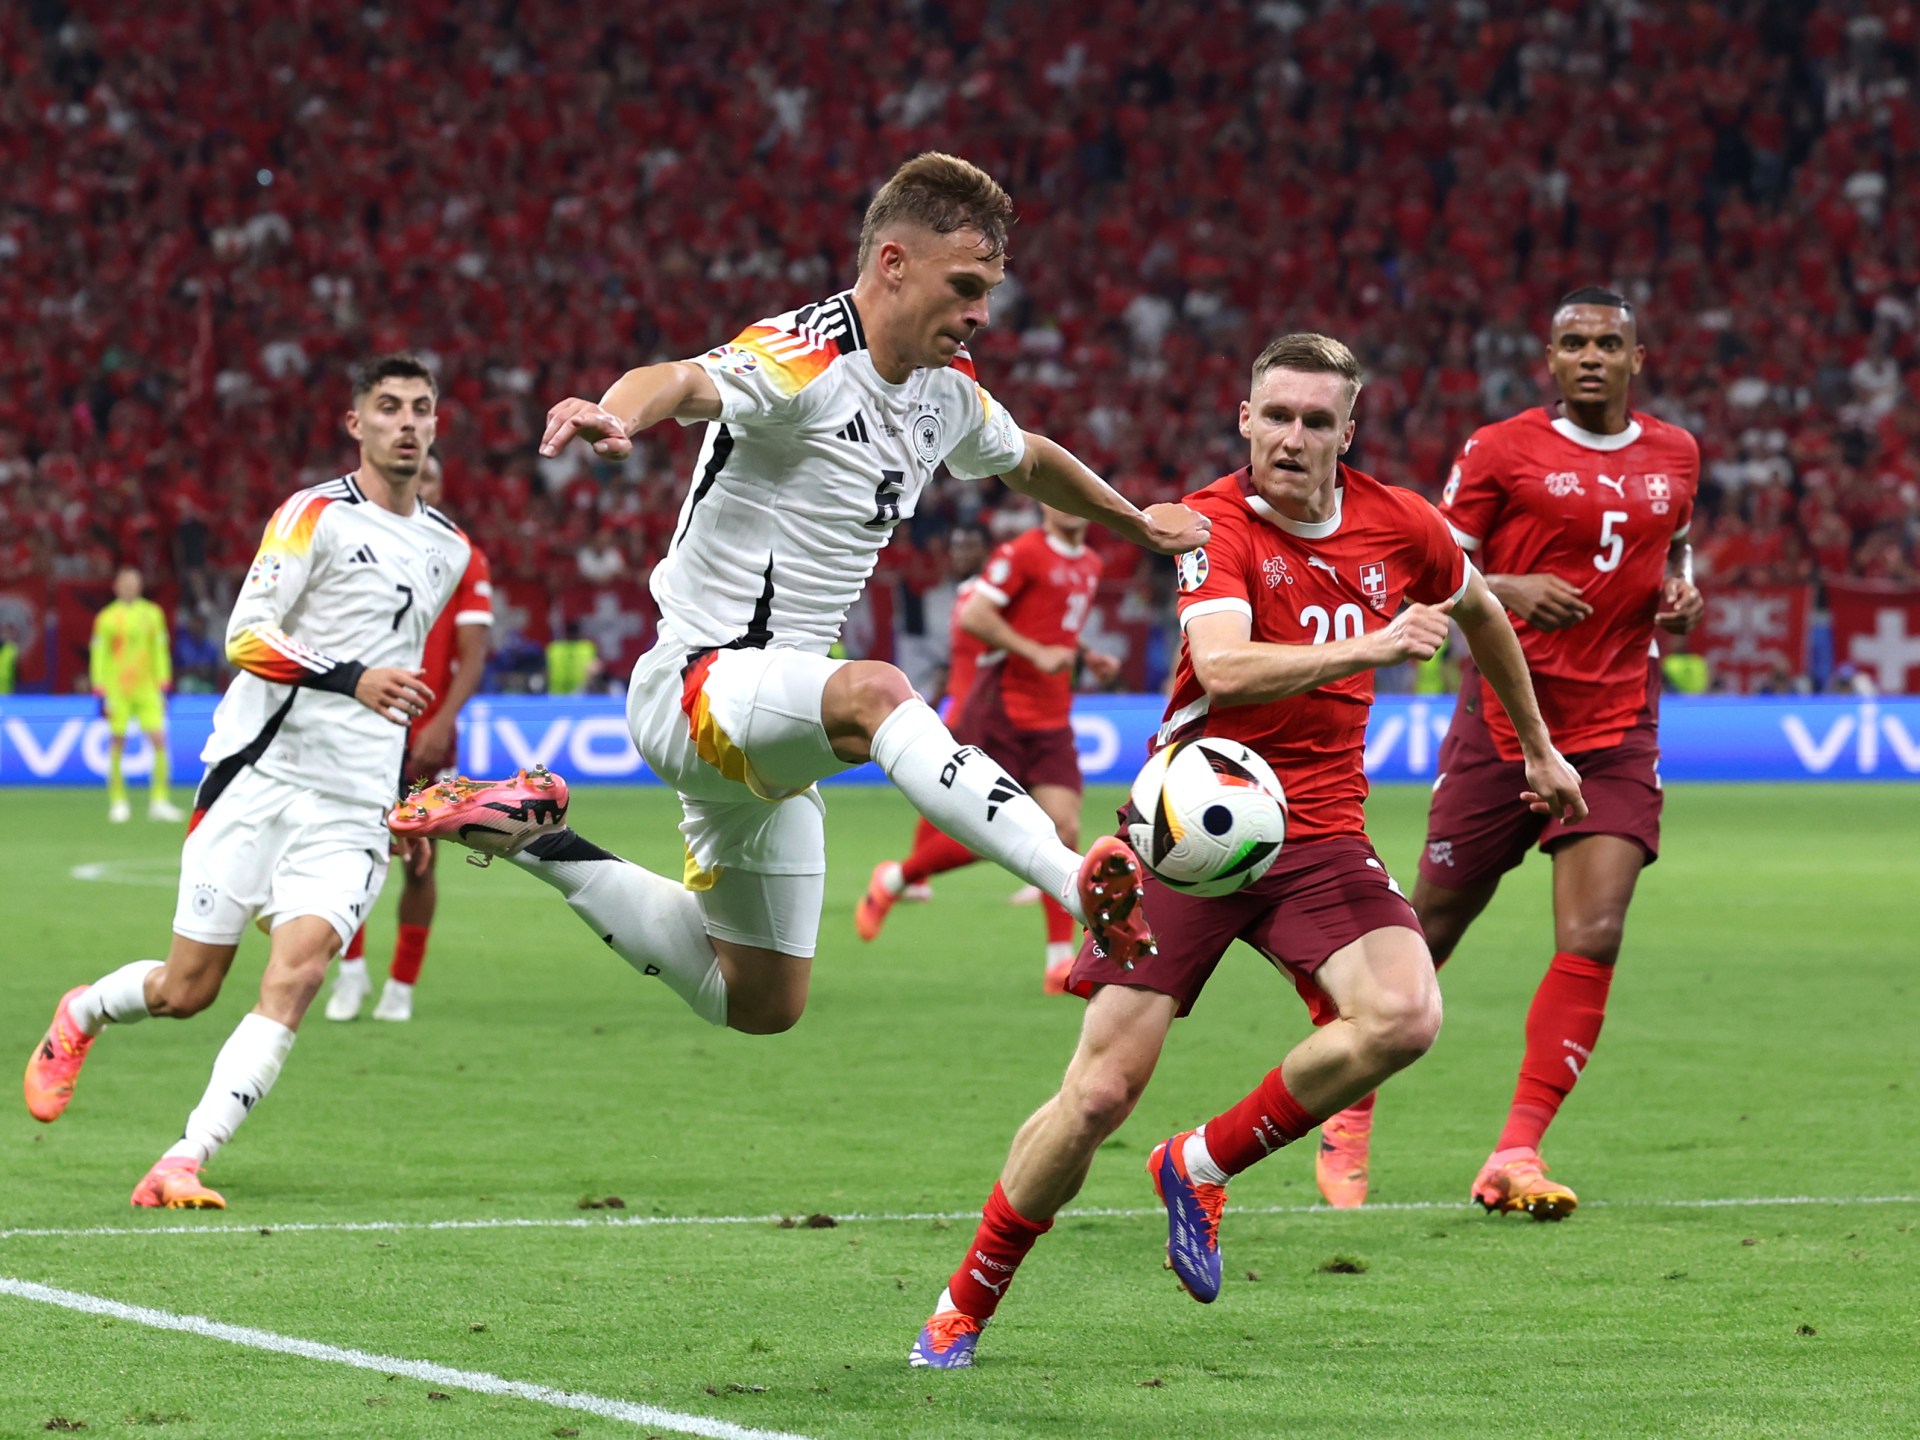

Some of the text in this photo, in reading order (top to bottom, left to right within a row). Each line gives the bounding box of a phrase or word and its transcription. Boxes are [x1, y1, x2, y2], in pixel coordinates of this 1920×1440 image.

[864, 470, 904, 528] 6
[1593, 511, 1629, 572] 5
[391, 584, 413, 633] 7
[1300, 603, 1364, 646] 20
[456, 702, 646, 774] ivo
[1362, 701, 1450, 773] vi
